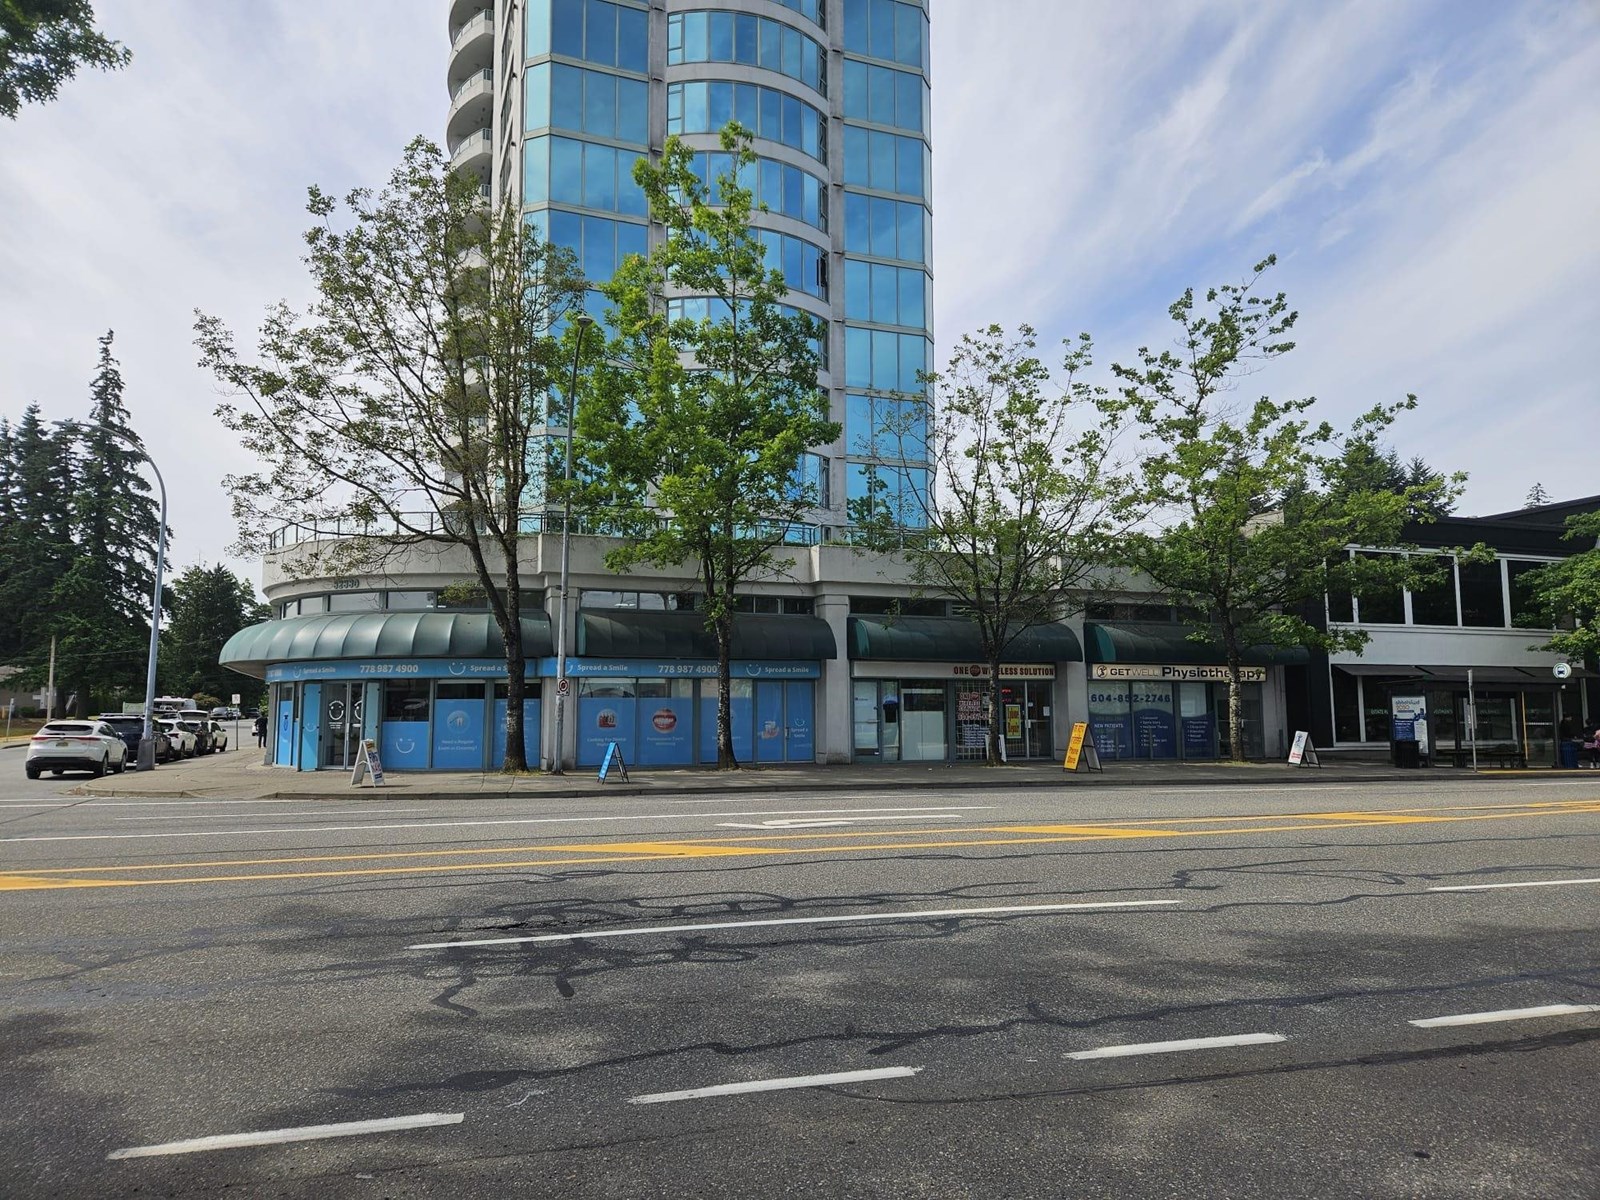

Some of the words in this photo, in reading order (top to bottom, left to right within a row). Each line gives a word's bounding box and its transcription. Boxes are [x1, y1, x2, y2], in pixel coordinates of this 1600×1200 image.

[360, 665, 376, 673] 778
[377, 665, 393, 673] 987
[395, 664, 419, 673] 4900
[658, 665, 675, 673] 778
[677, 665, 694, 673] 987
[695, 665, 718, 673] 4900
[953, 666, 969, 675] ONE
[1019, 667, 1054, 676] SOLUTION
[1161, 666, 1262, 680] Physiotheapy
